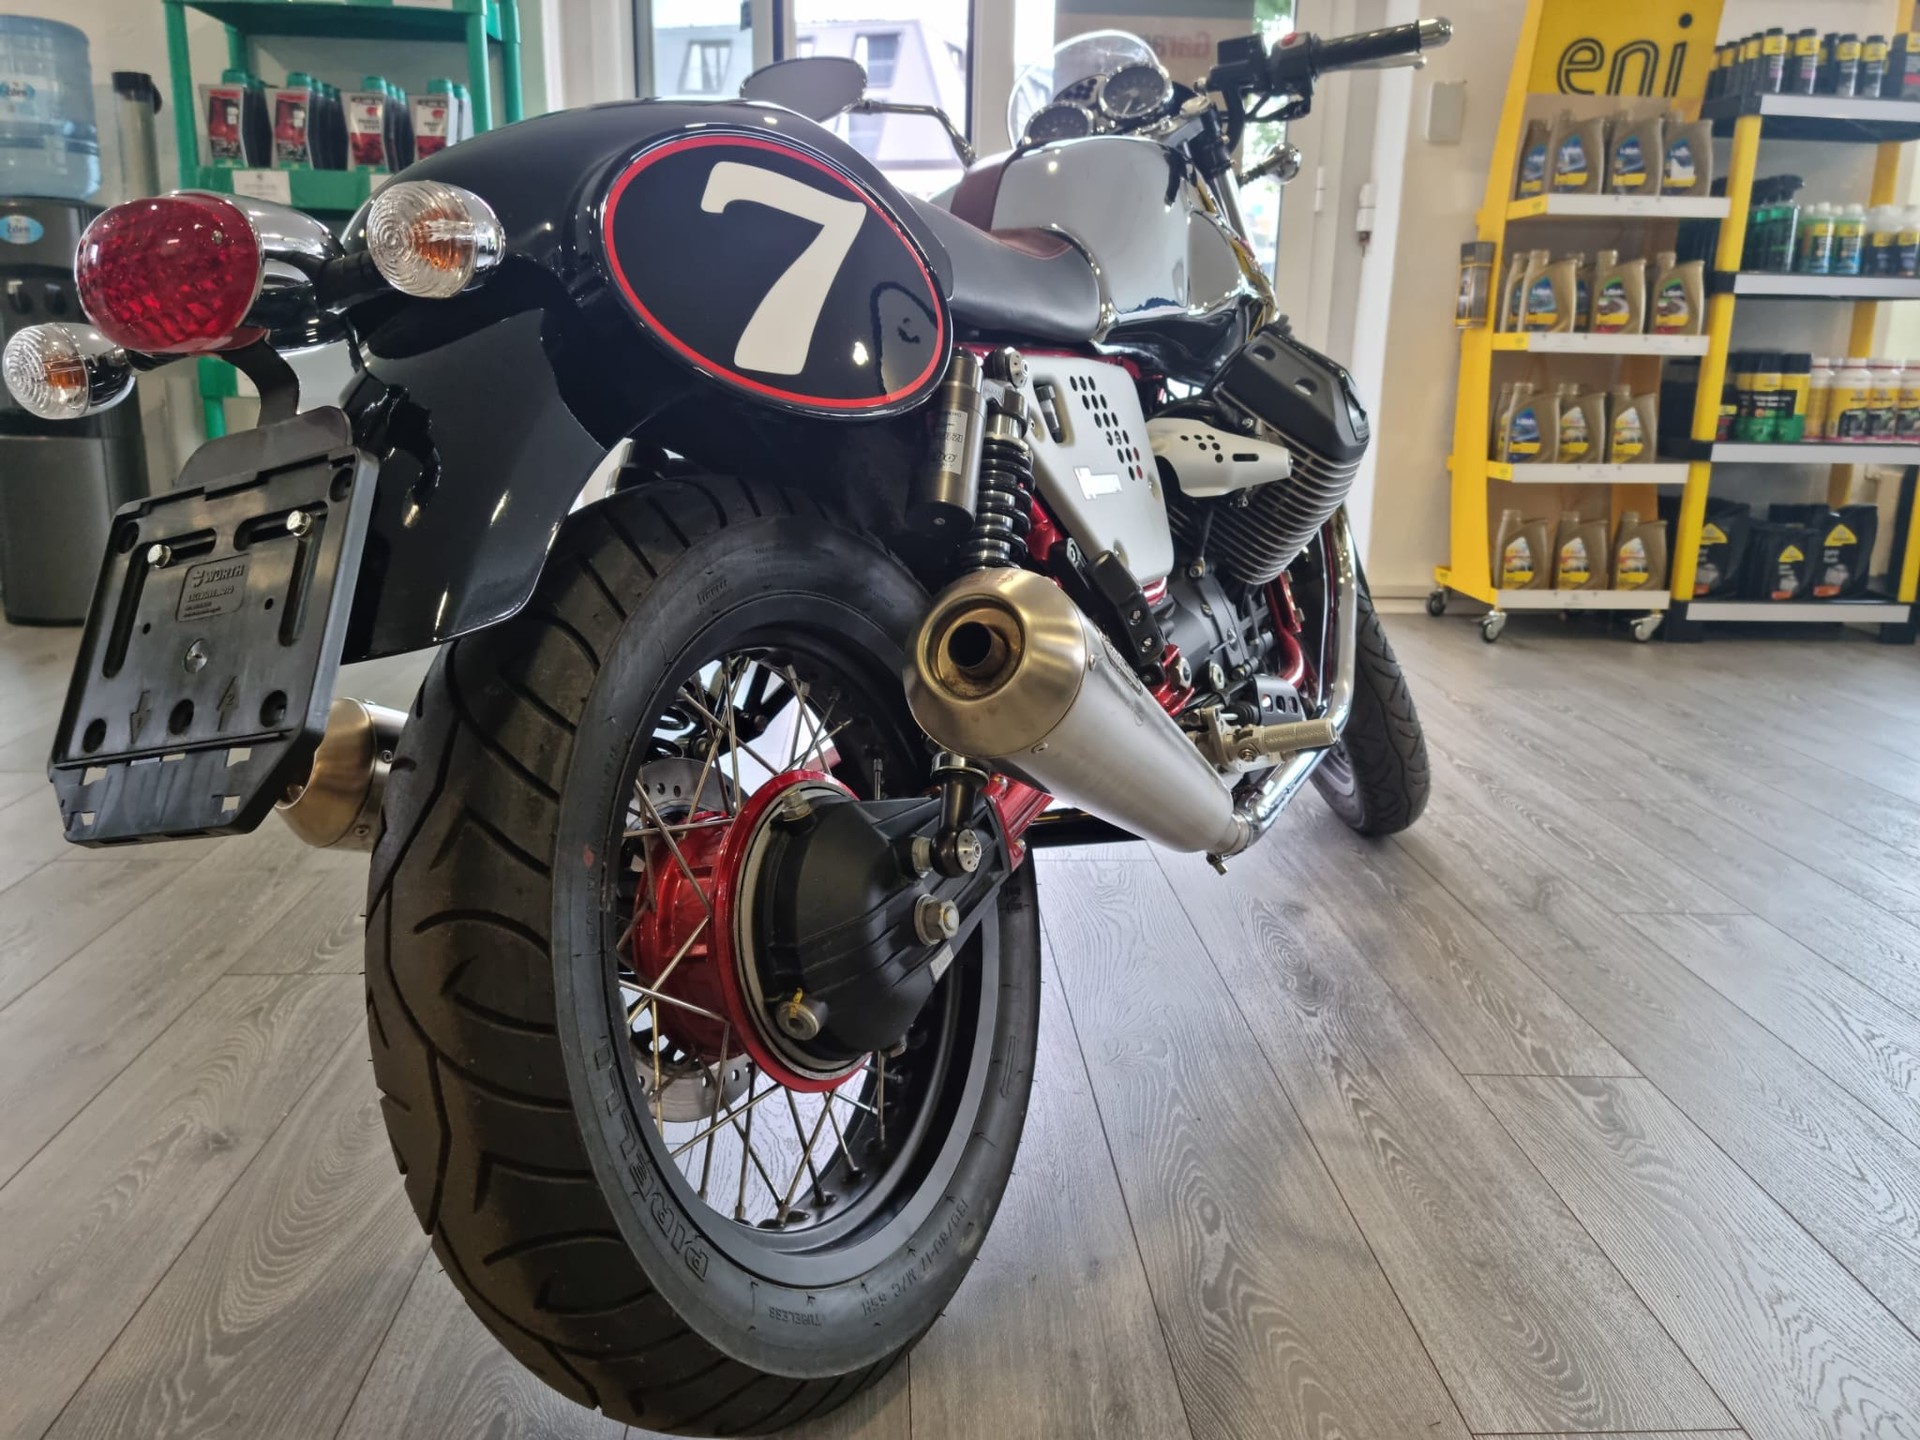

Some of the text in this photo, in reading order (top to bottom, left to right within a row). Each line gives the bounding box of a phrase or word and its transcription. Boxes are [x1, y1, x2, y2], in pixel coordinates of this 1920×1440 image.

[1556, 13, 1693, 96] eni
[700, 161, 867, 376] 7
[594, 1035, 710, 1283] PIRELLI
[768, 1305, 822, 1328] TUBELESS
